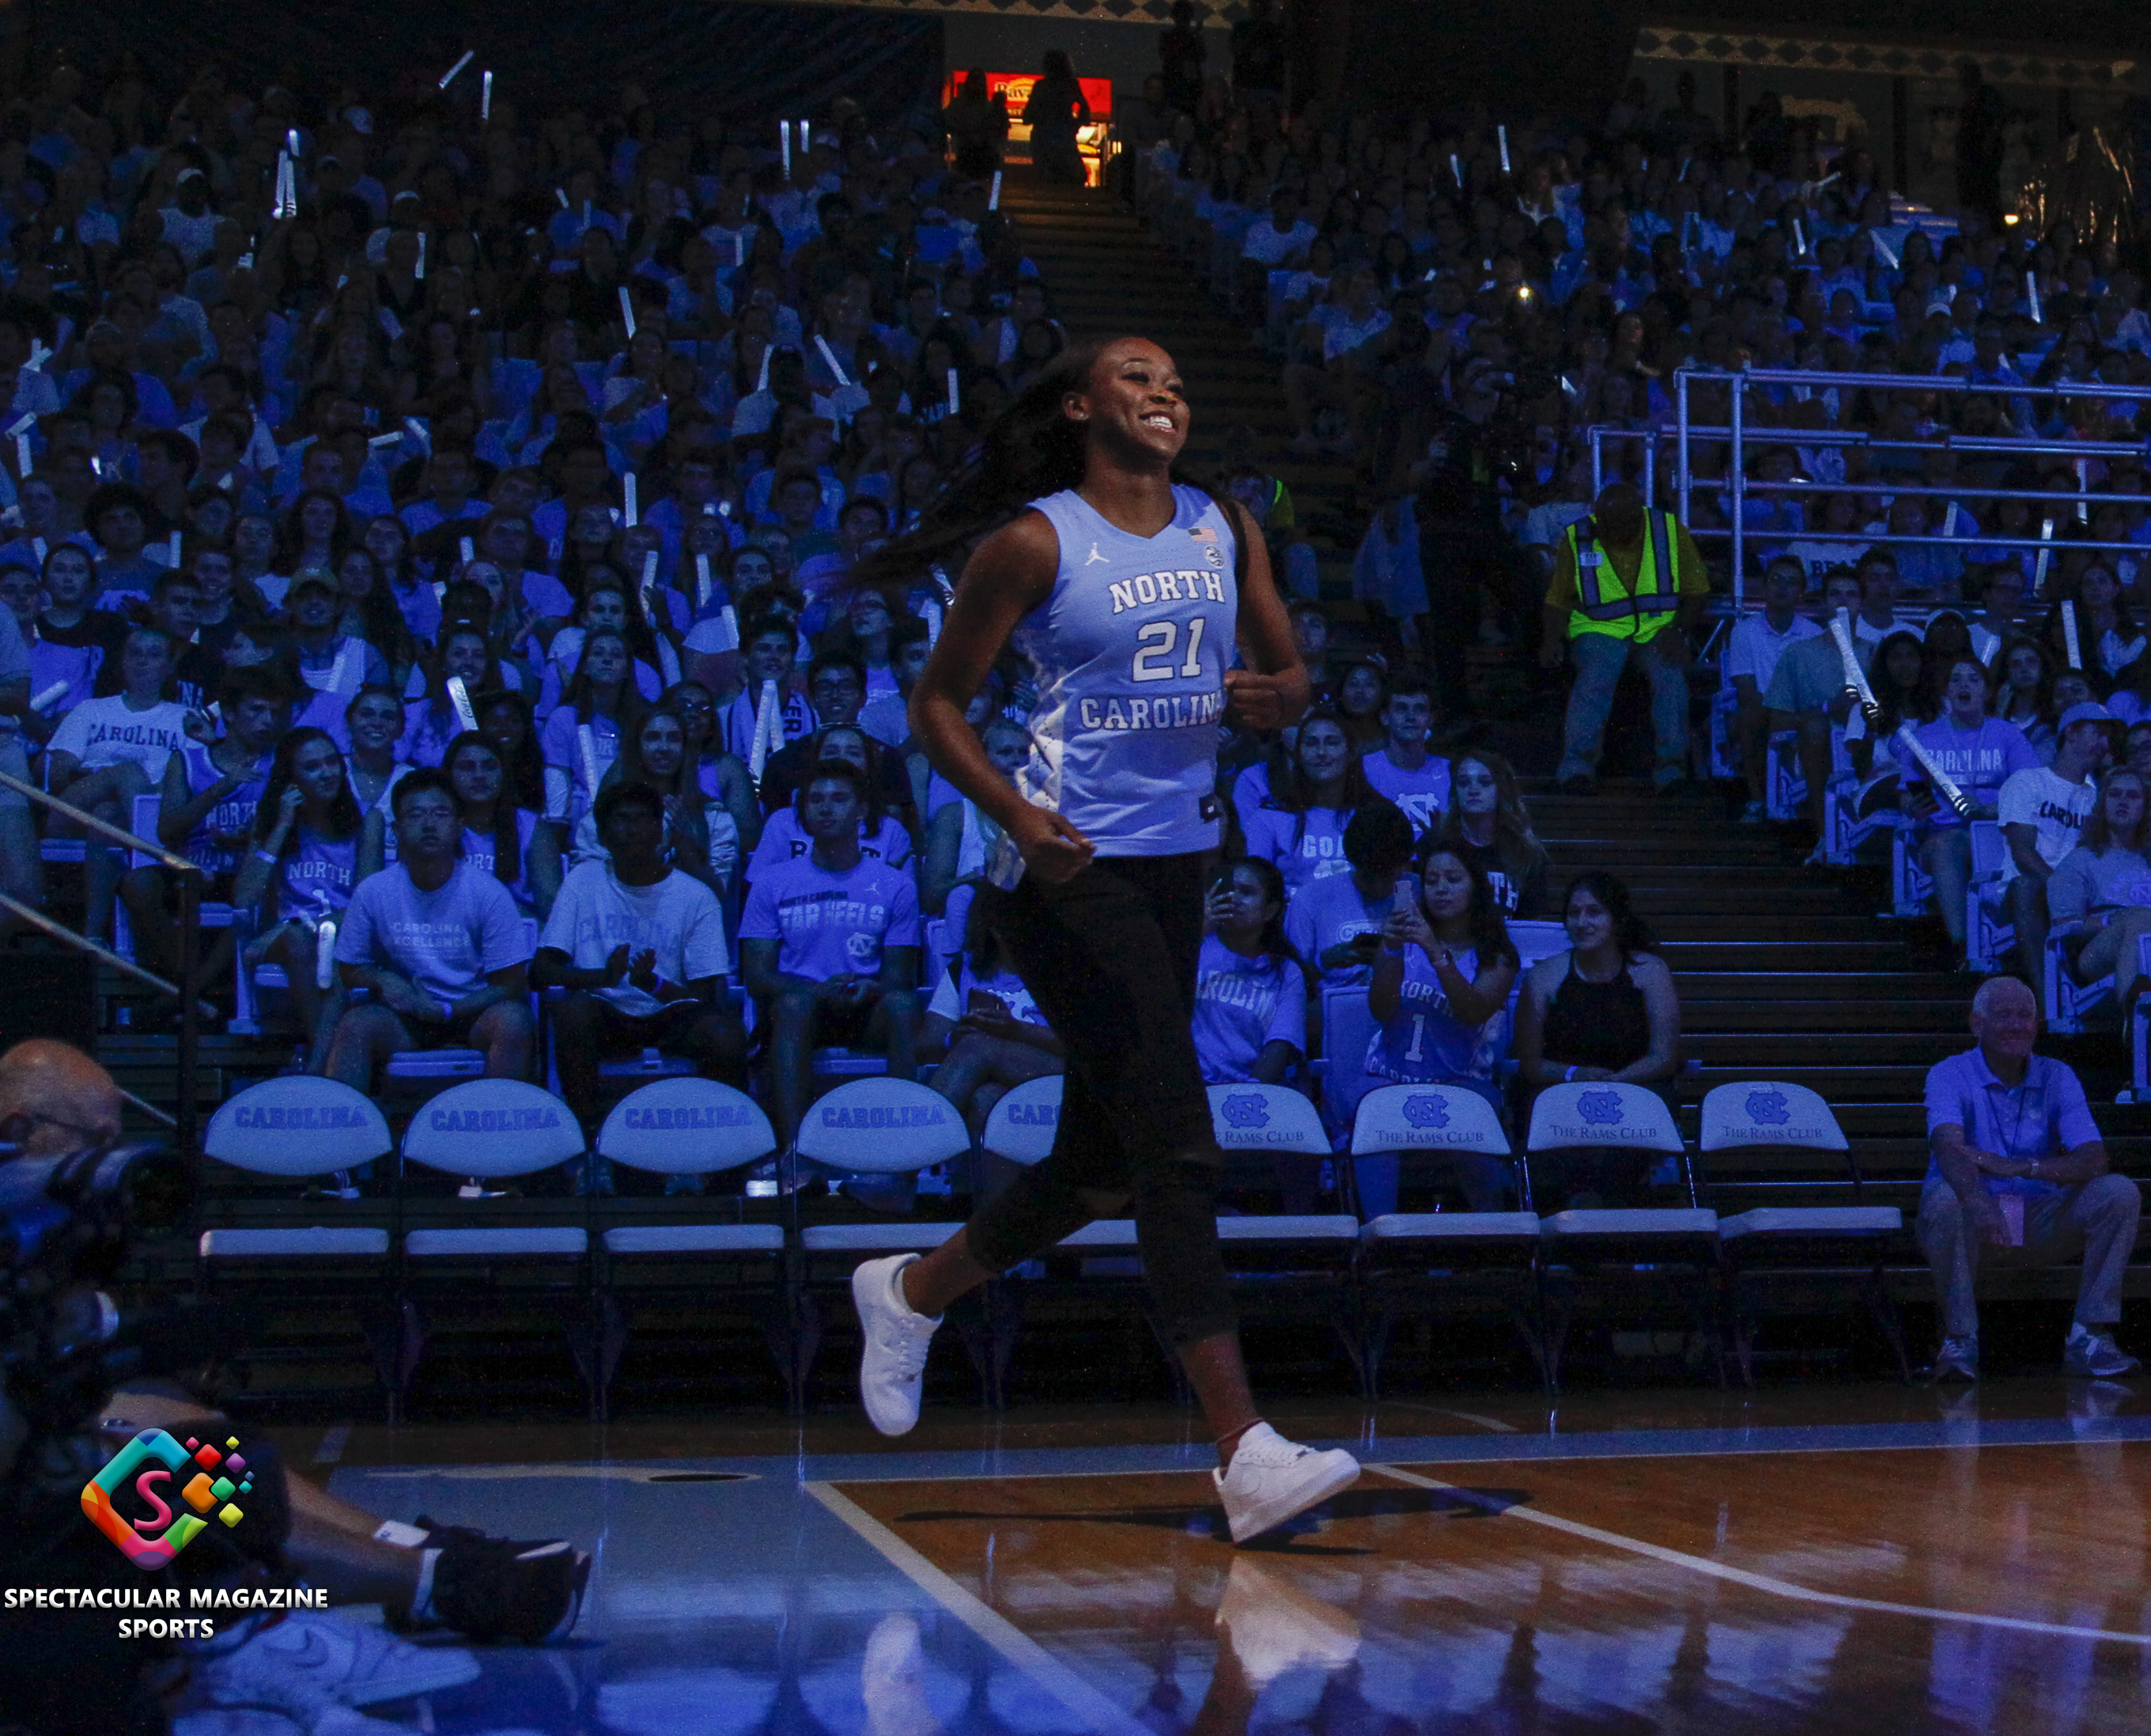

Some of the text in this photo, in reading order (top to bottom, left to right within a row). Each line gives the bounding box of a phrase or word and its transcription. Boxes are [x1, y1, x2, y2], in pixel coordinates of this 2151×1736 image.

[1108, 569, 1226, 614] NORTH
[1132, 618, 1205, 682] 21
[288, 861, 351, 886] NORTH
[1404, 1013, 1425, 1063] 1
[235, 1106, 369, 1129] CAROLINA
[430, 1109, 561, 1132] CAROLINA
[624, 1106, 752, 1130] CAROLINA
[821, 1105, 947, 1129] CAROLINA
